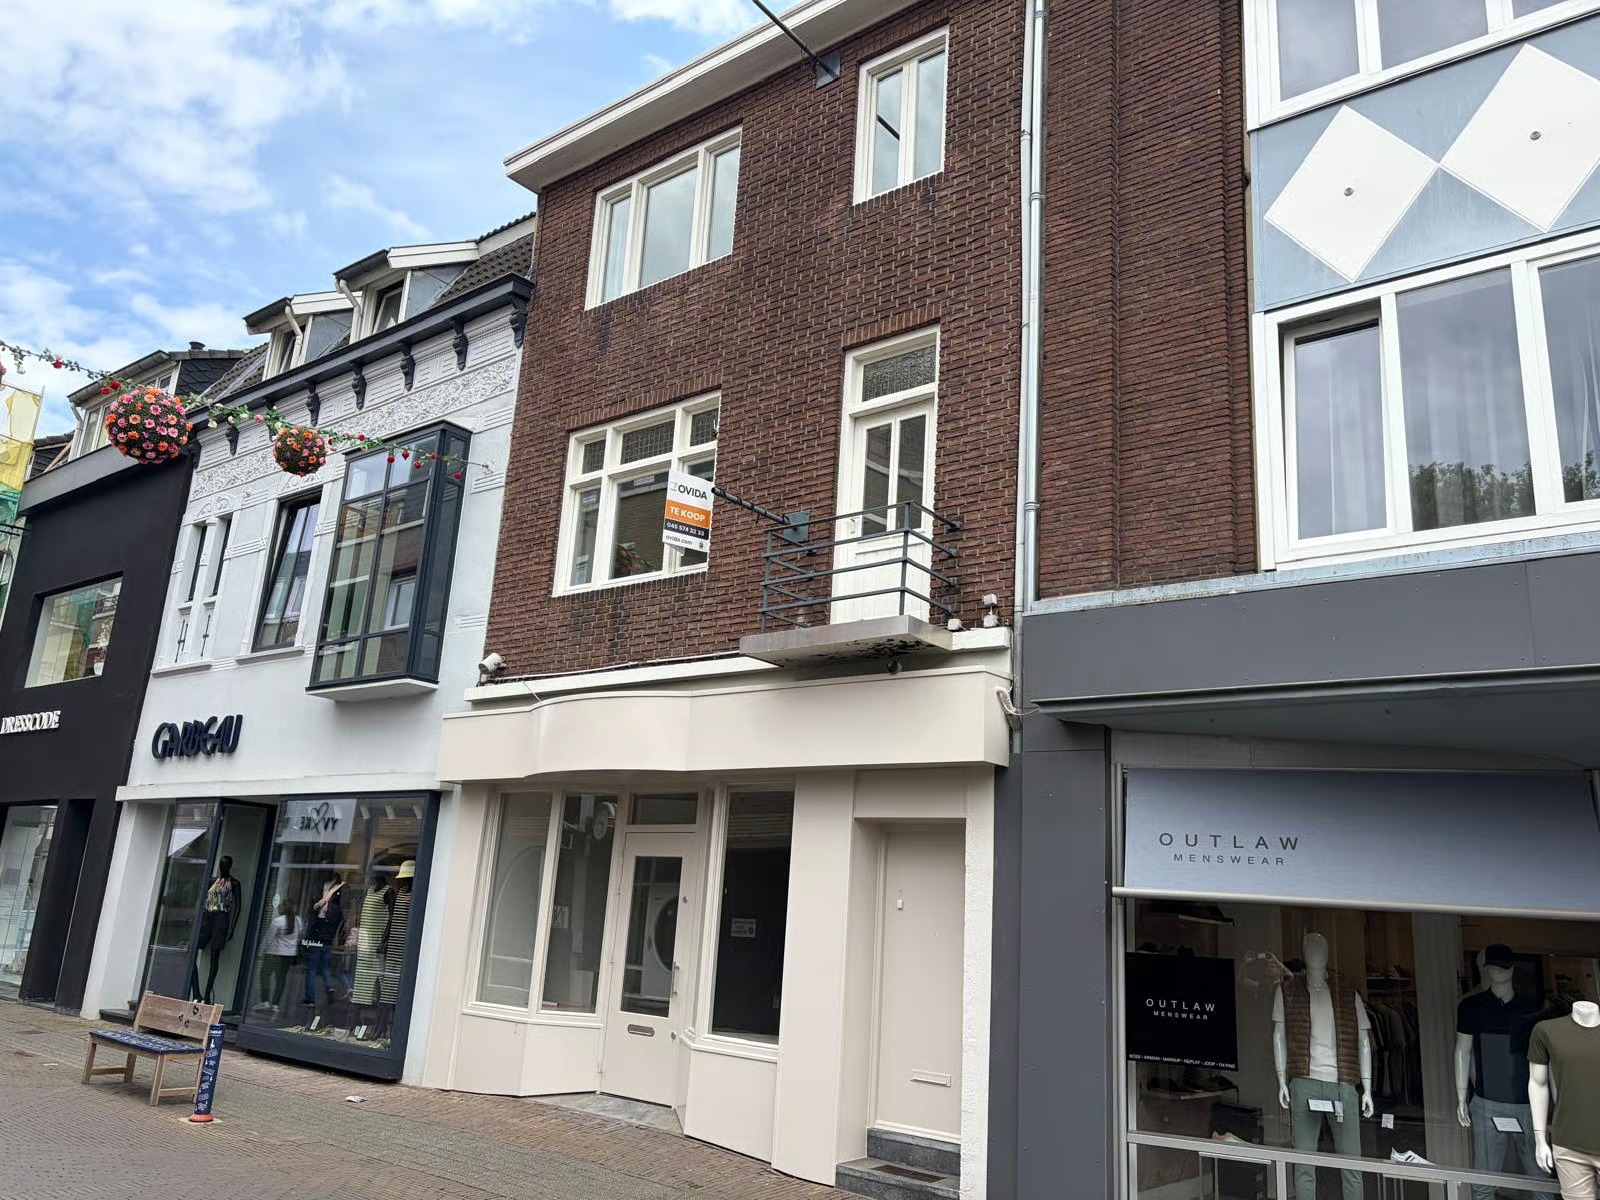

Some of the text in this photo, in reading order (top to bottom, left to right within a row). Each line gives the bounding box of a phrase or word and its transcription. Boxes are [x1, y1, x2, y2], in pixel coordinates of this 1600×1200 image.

[678, 484, 708, 500] OVIDA
[670, 506, 706, 522] TE KOOP
[666, 522, 678, 530] 045
[678, 524, 689, 533] 574
[665, 534, 693, 546] ovida.com
[0, 710, 62, 735] DRESSCODE
[1159, 832, 1299, 851] OUTLAW
[1173, 853, 1285, 866] MENSWEAR
[1145, 998, 1216, 1012] OUTLAW
[1153, 1010, 1209, 1021] MENSWEAR
